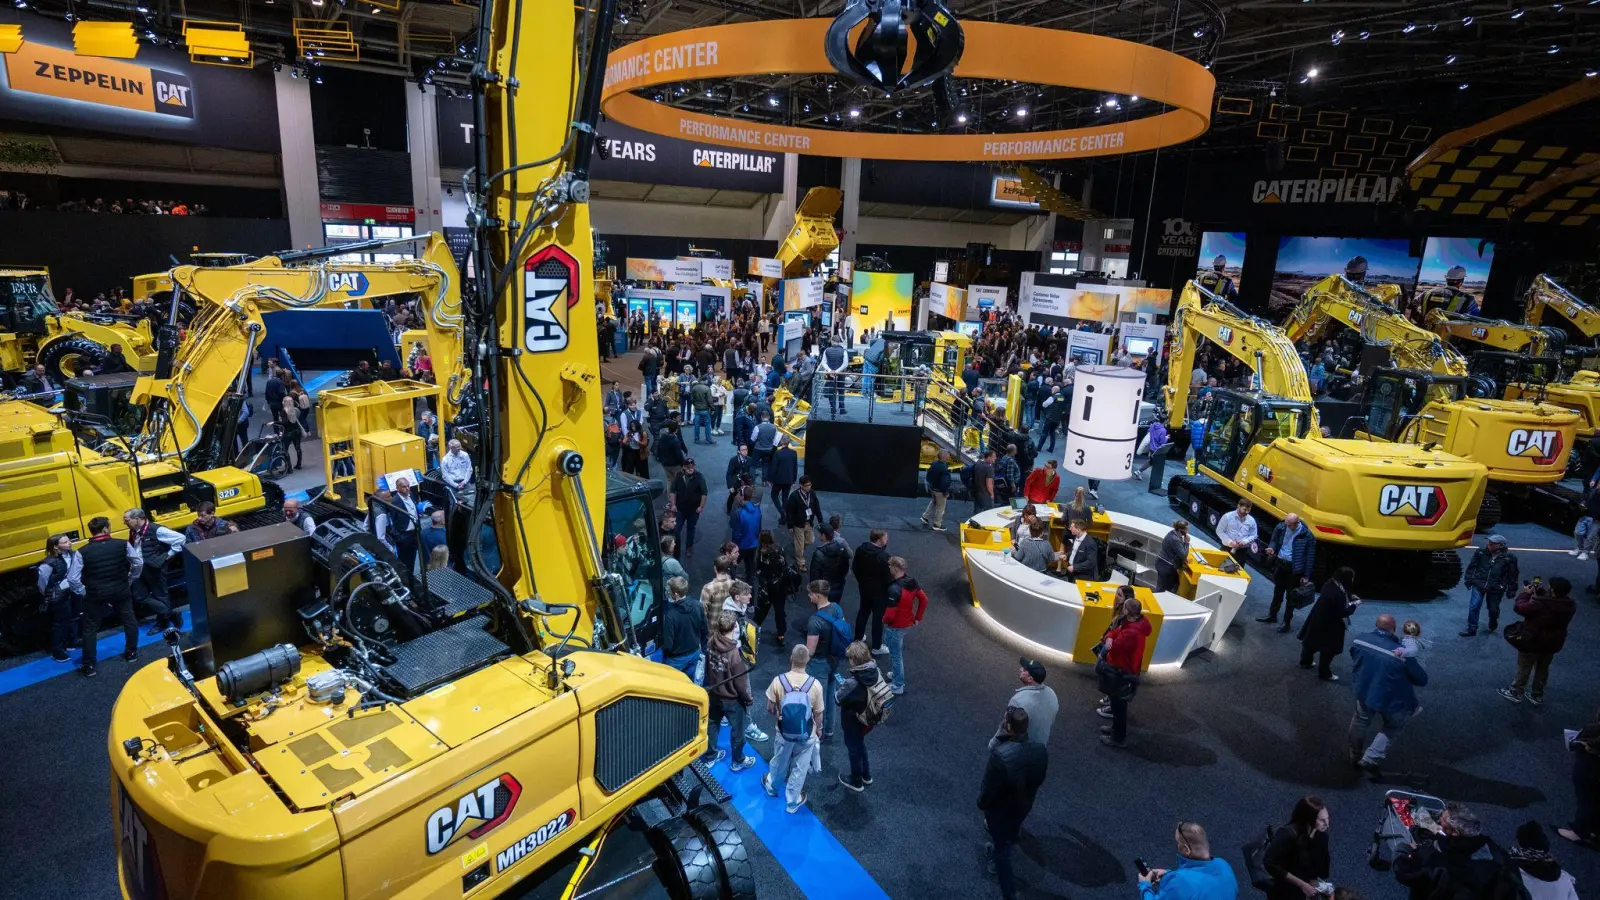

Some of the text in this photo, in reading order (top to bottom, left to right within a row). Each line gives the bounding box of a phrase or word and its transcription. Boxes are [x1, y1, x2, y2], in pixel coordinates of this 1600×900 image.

[654, 41, 718, 73] CENTER
[34, 61, 144, 96] ZEPPELIN
[156, 81, 188, 107] CAT
[680, 119, 811, 150] PERFORMANCE CENTER
[984, 132, 1125, 156] PERFORMANCE CENTER
[693, 149, 773, 173] CATERPILLAR
[329, 272, 359, 292] CAT
[1032, 290, 1050, 298] Customer
[525, 271, 568, 352] CAT
[1347, 309, 1362, 325] CAT
[1218, 325, 1232, 341] CAT
[1471, 327, 1486, 339] CAT
[1508, 429, 1556, 457] CAT
[1075, 448, 1085, 466] 3
[1125, 453, 1132, 470] 3
[1258, 463, 1271, 480] CAT
[219, 488, 235, 499] 320
[1379, 484, 1434, 517] CAT
[427, 776, 500, 854] CAT
[497, 812, 568, 873] MH3022
